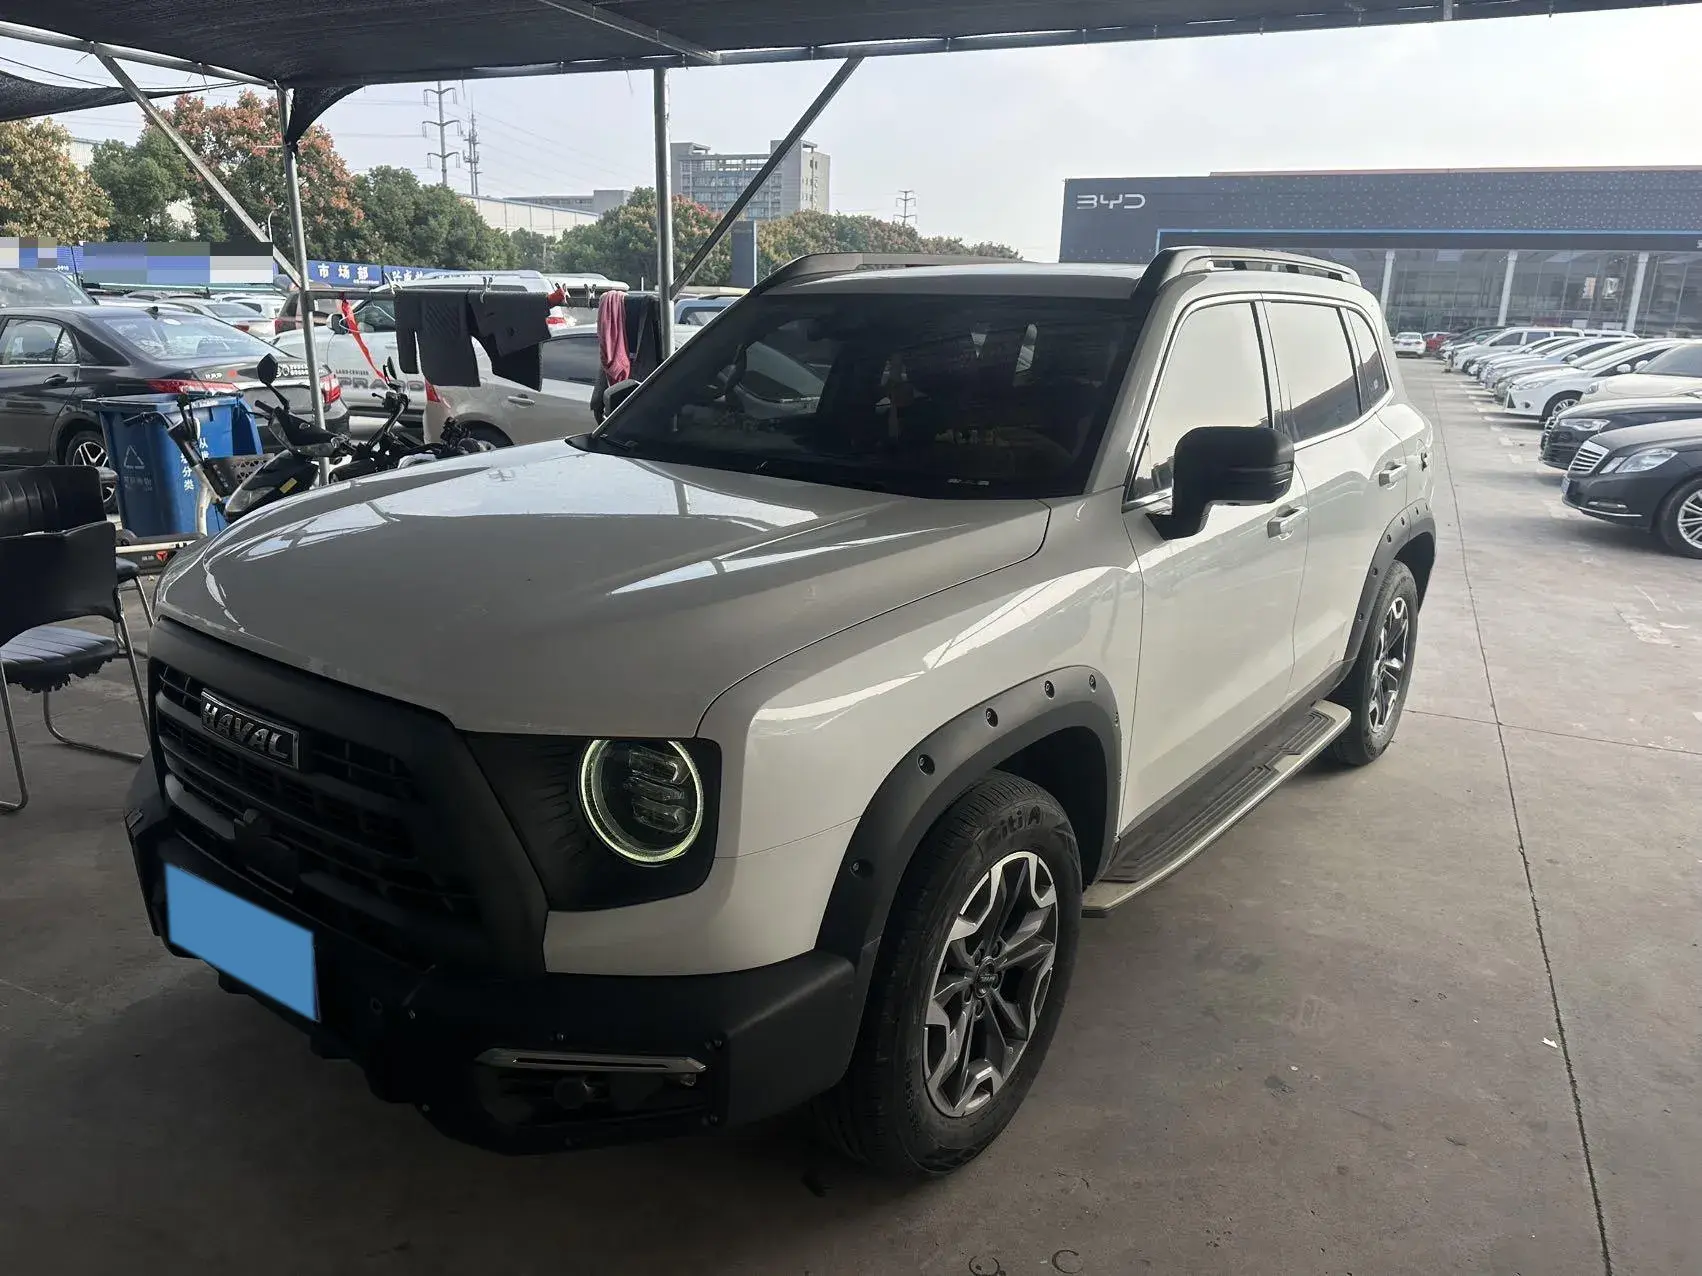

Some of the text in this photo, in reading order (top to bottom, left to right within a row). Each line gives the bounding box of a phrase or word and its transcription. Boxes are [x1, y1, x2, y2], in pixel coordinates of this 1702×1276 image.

[1076, 193, 1146, 210] BYD
[317, 263, 369, 280] 市场部
[203, 703, 288, 759] HAVAL
